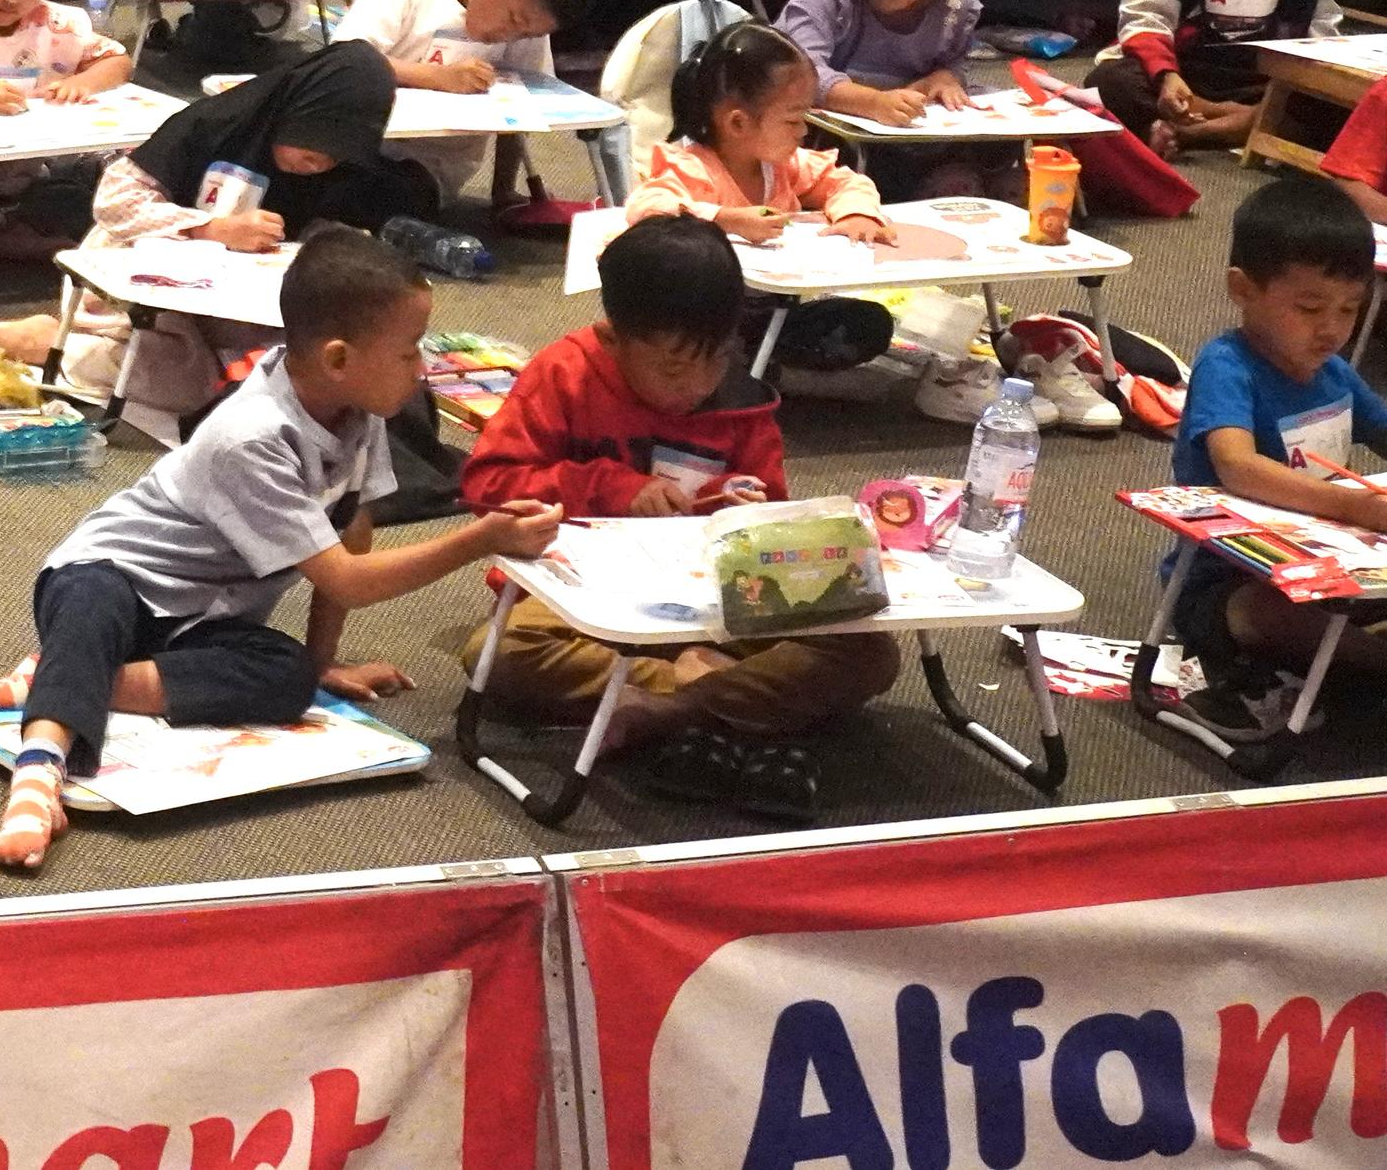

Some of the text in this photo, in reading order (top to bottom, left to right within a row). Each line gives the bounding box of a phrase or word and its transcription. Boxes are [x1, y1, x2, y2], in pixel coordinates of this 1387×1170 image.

[428, 50, 444, 66] A
[205, 186, 218, 204] A
[1290, 447, 1308, 470] A
